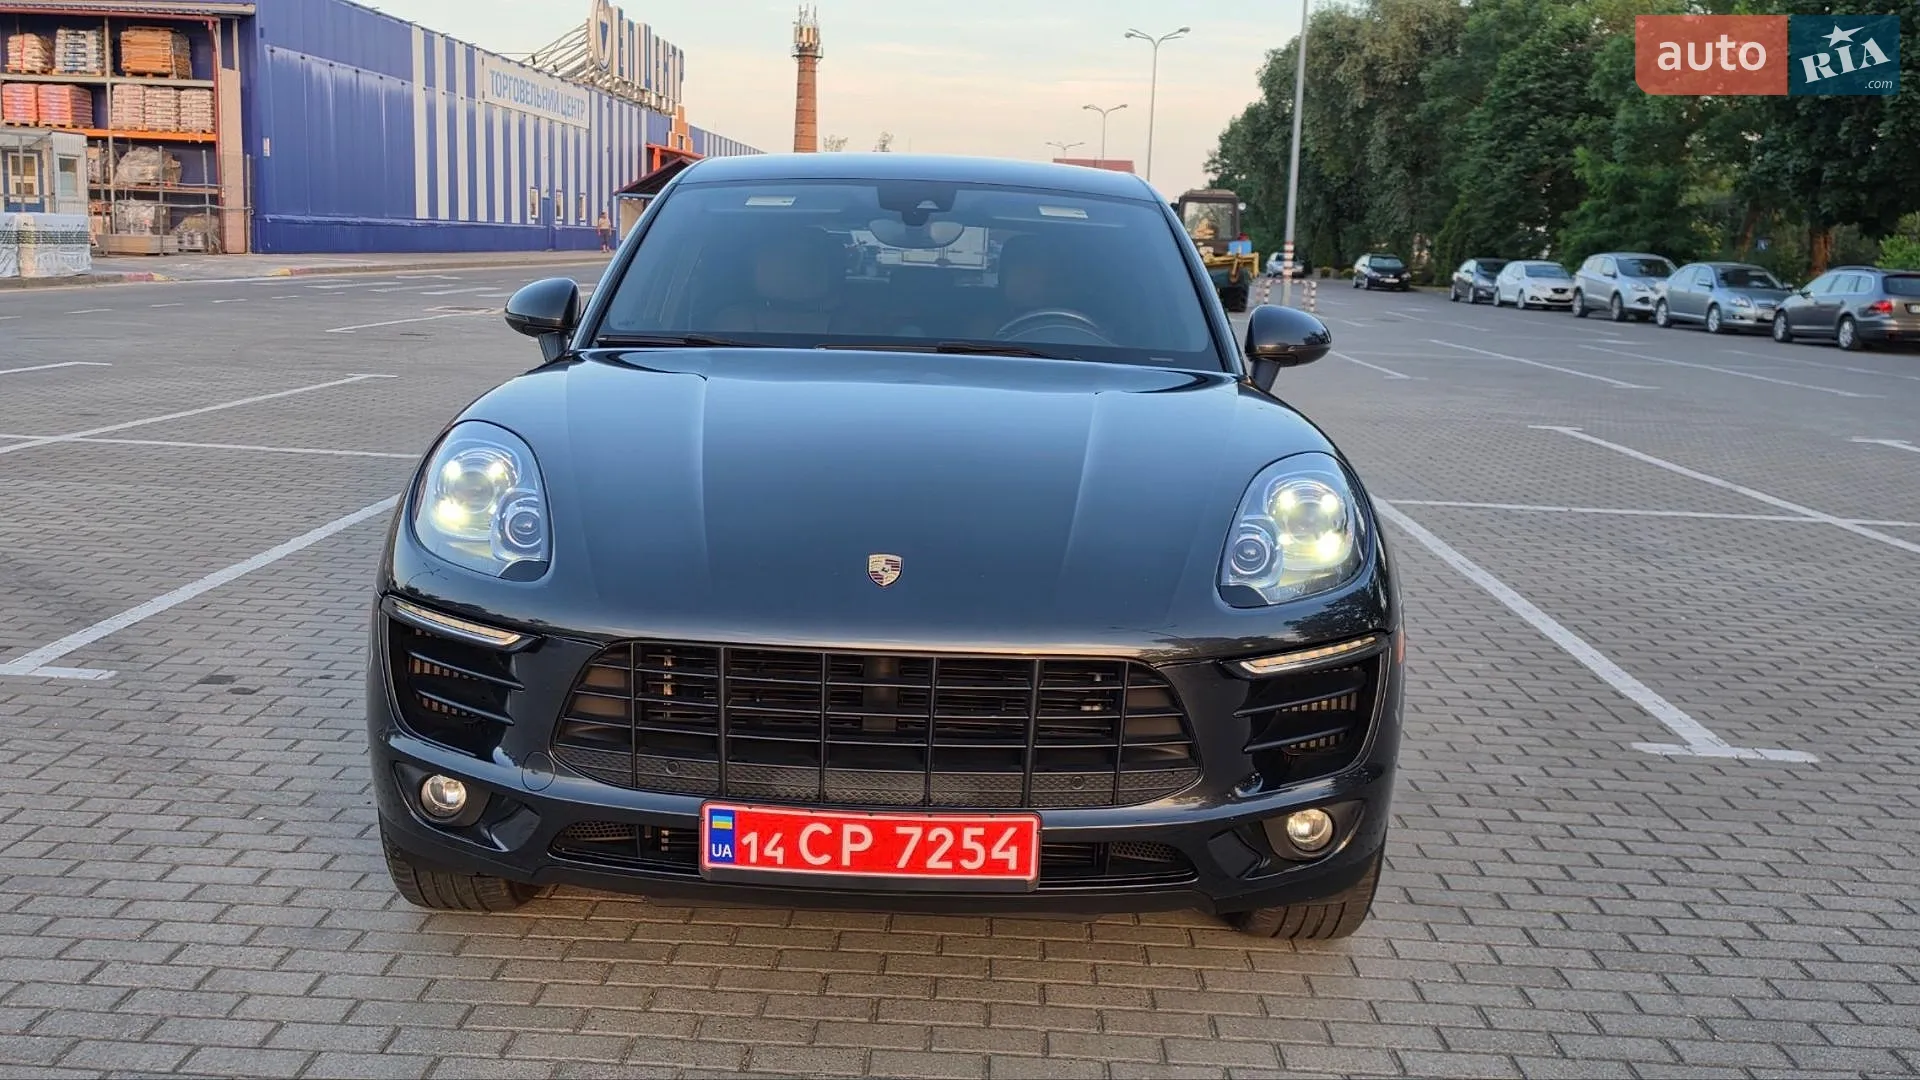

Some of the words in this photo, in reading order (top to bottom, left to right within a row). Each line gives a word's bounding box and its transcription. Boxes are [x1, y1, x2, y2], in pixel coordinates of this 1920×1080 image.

[489, 68, 560, 113] ТОРГОВЕЛЬНИЙ
[560, 91, 586, 121] ЦЕНТР
[711, 843, 733, 859] UA
[741, 831, 785, 865] 14
[799, 822, 874, 867] CP
[895, 826, 1018, 871] 7254
